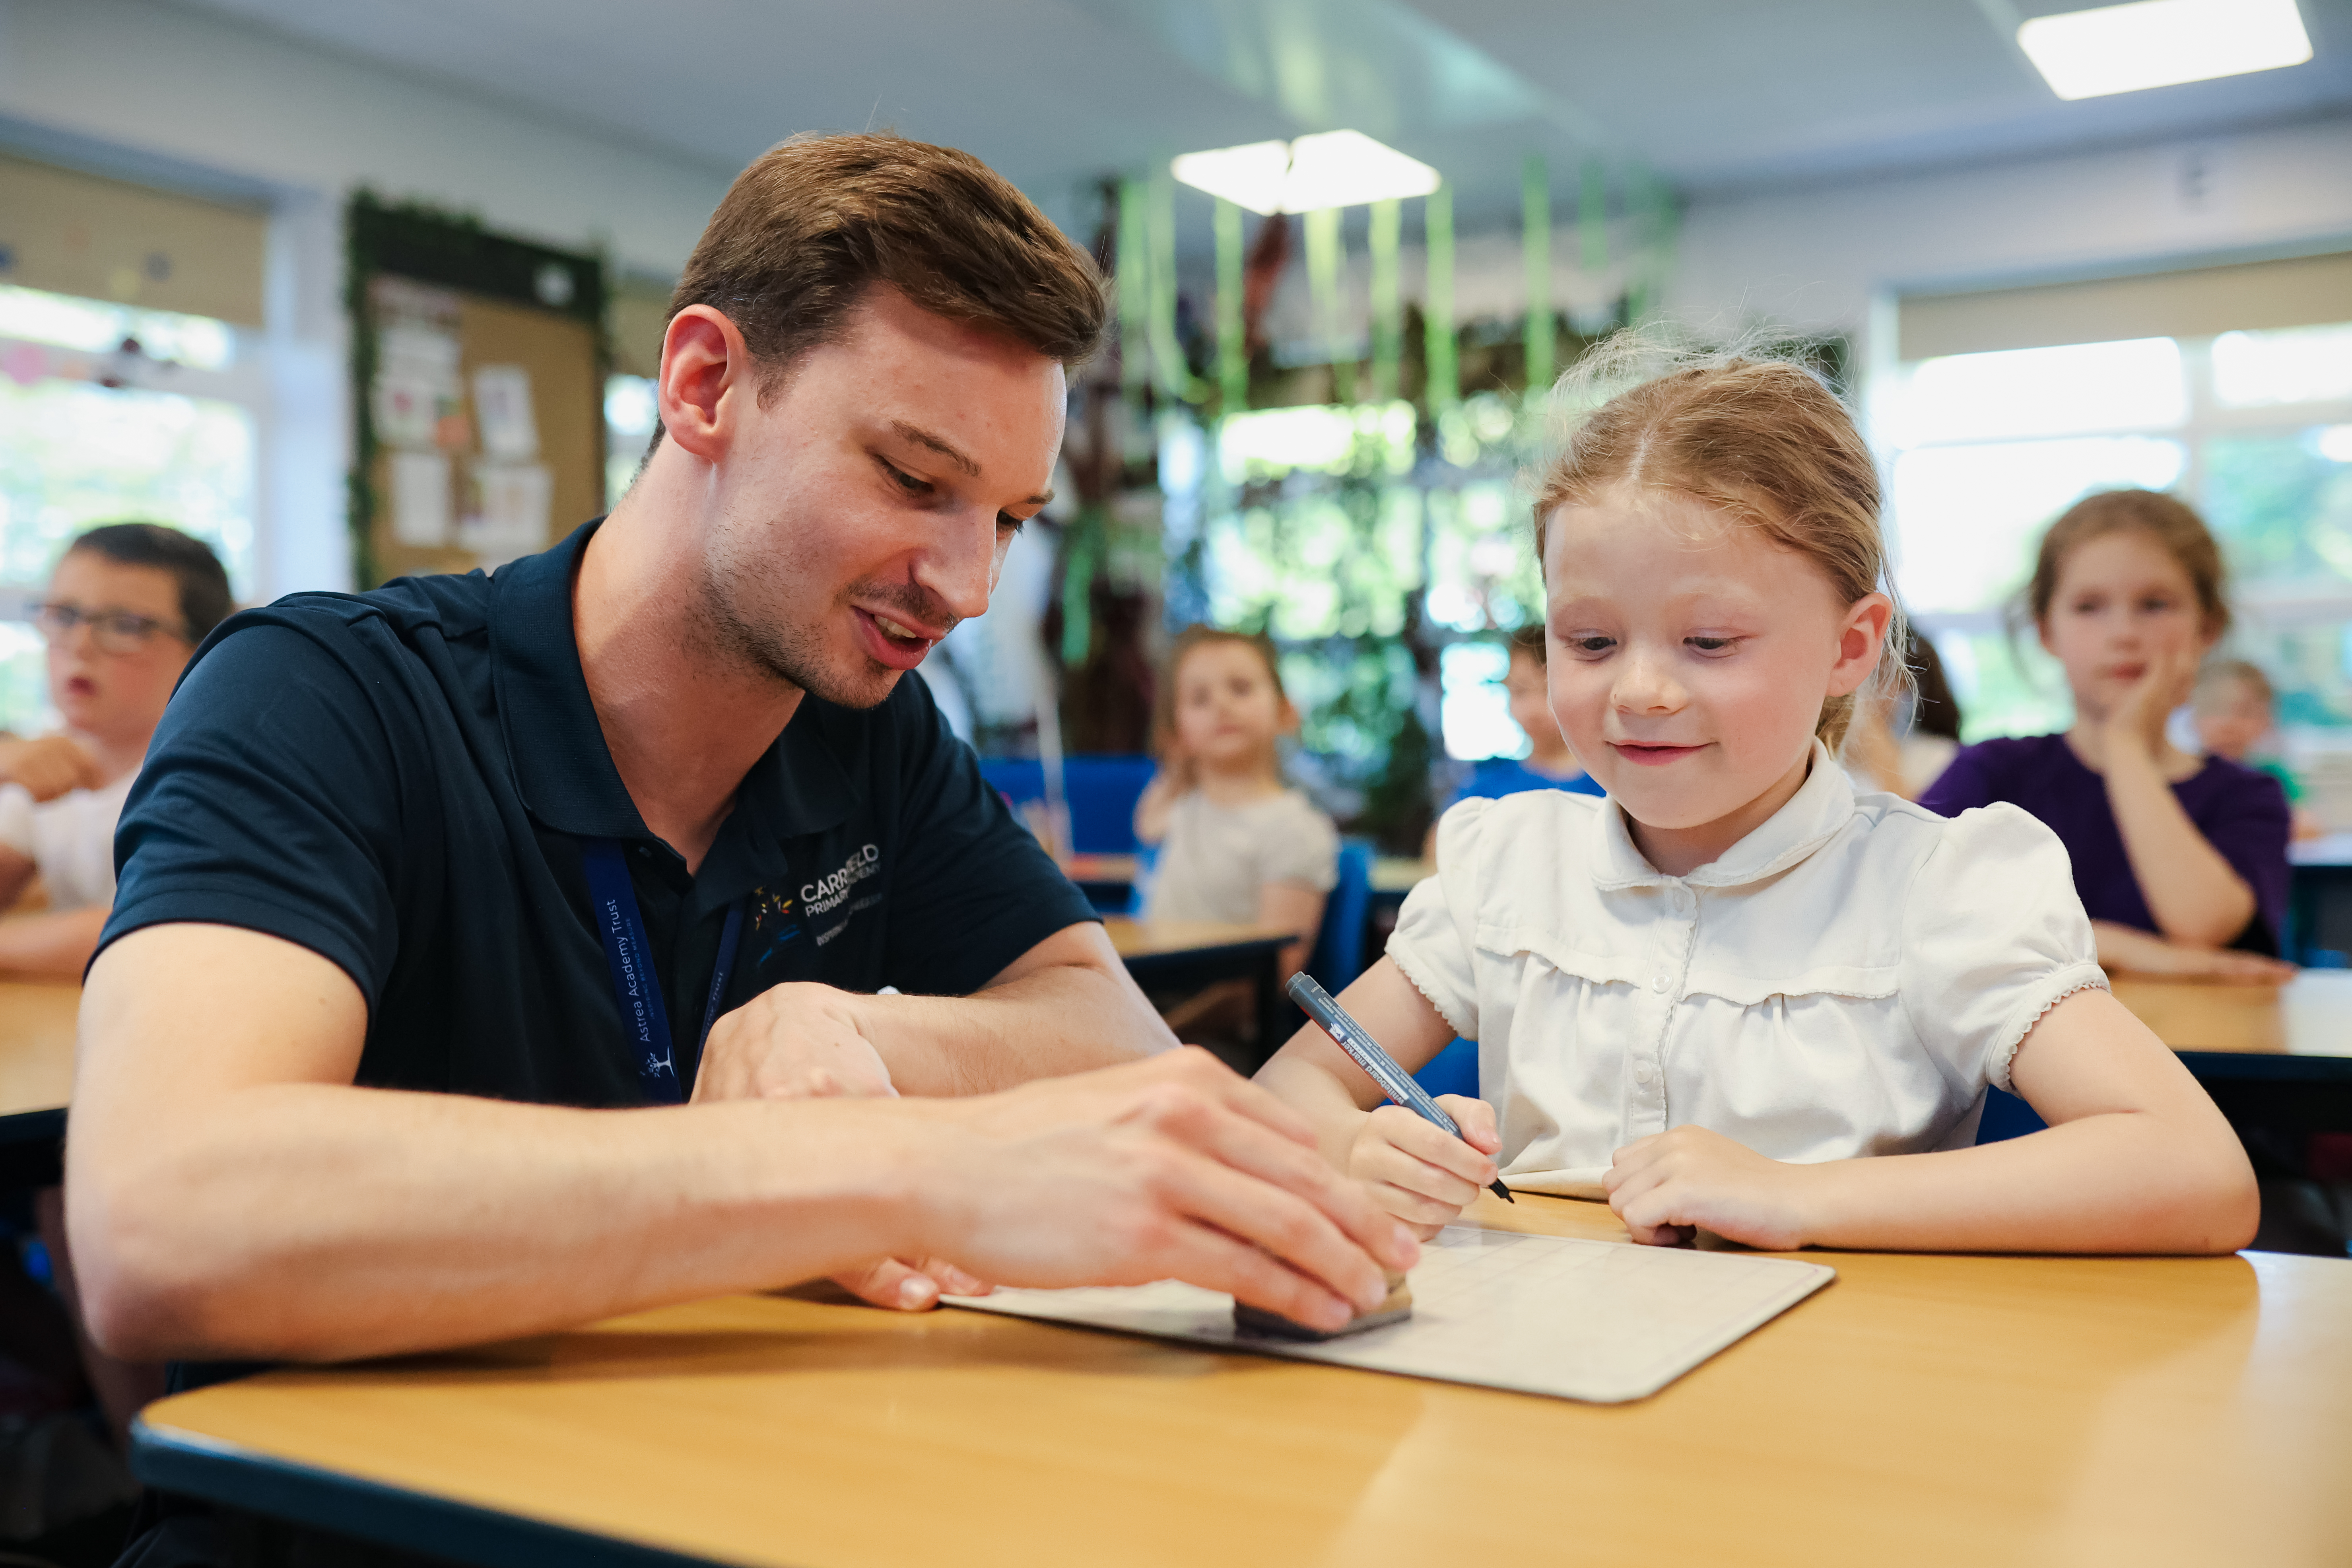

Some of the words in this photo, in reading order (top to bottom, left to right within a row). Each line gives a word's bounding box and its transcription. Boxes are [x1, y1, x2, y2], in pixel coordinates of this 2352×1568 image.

[607, 899, 622, 934] Trust
[625, 918, 637, 950] MEASURE
[616, 937, 639, 997] Academy
[635, 953, 645, 981] BEYOND
[633, 1001, 651, 1042] Astrea
[1341, 1041, 1367, 1066] marker
[1365, 1065, 1404, 1105] whiteboard
